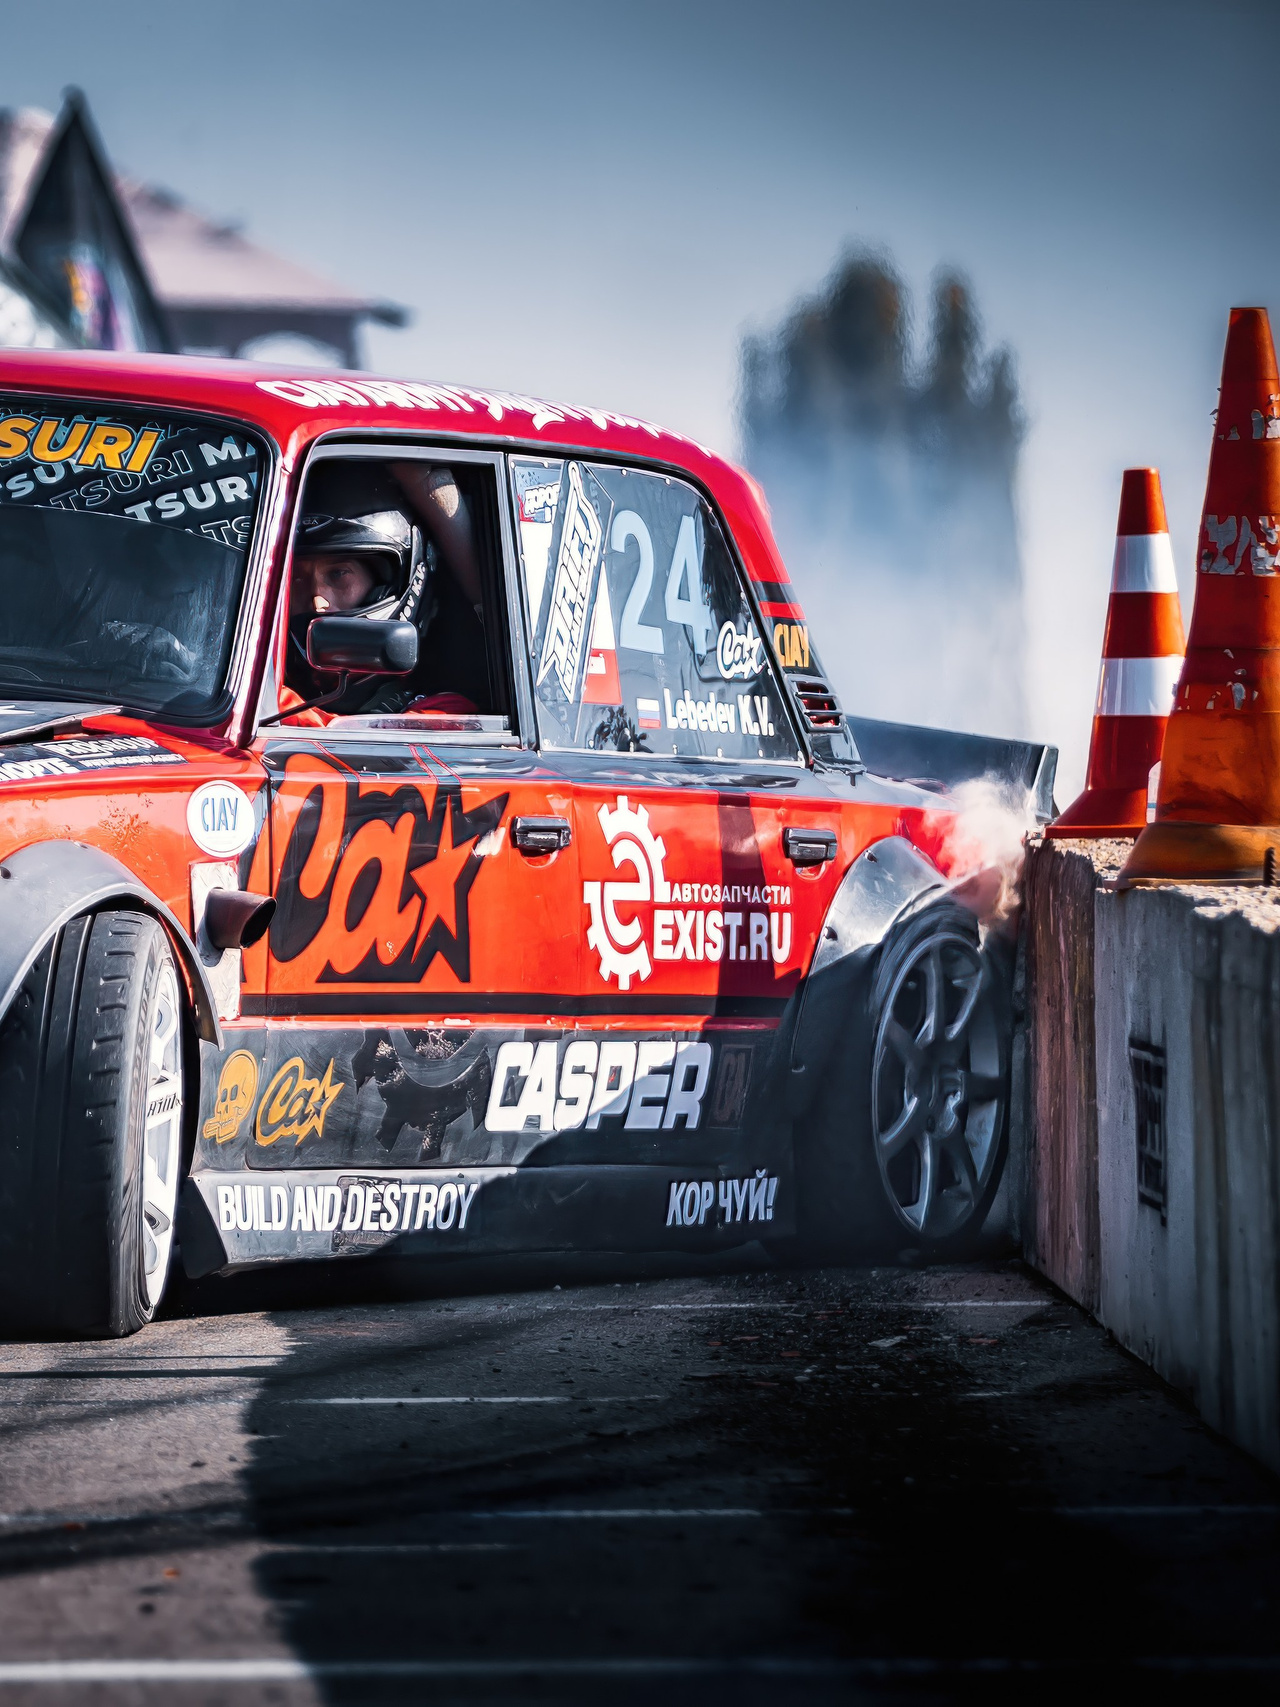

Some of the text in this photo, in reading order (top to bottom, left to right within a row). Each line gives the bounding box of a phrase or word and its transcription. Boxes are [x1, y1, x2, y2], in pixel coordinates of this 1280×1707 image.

[609, 509, 714, 656] 24
[663, 687, 775, 737] Lebedev K.V.
[671, 883, 792, 905] АВТОЗАПЧАСТИ
[653, 909, 793, 964] EXIST.RU
[484, 1040, 713, 1132] CASPER
[217, 1183, 480, 1232] BUILD AND DESTROY
